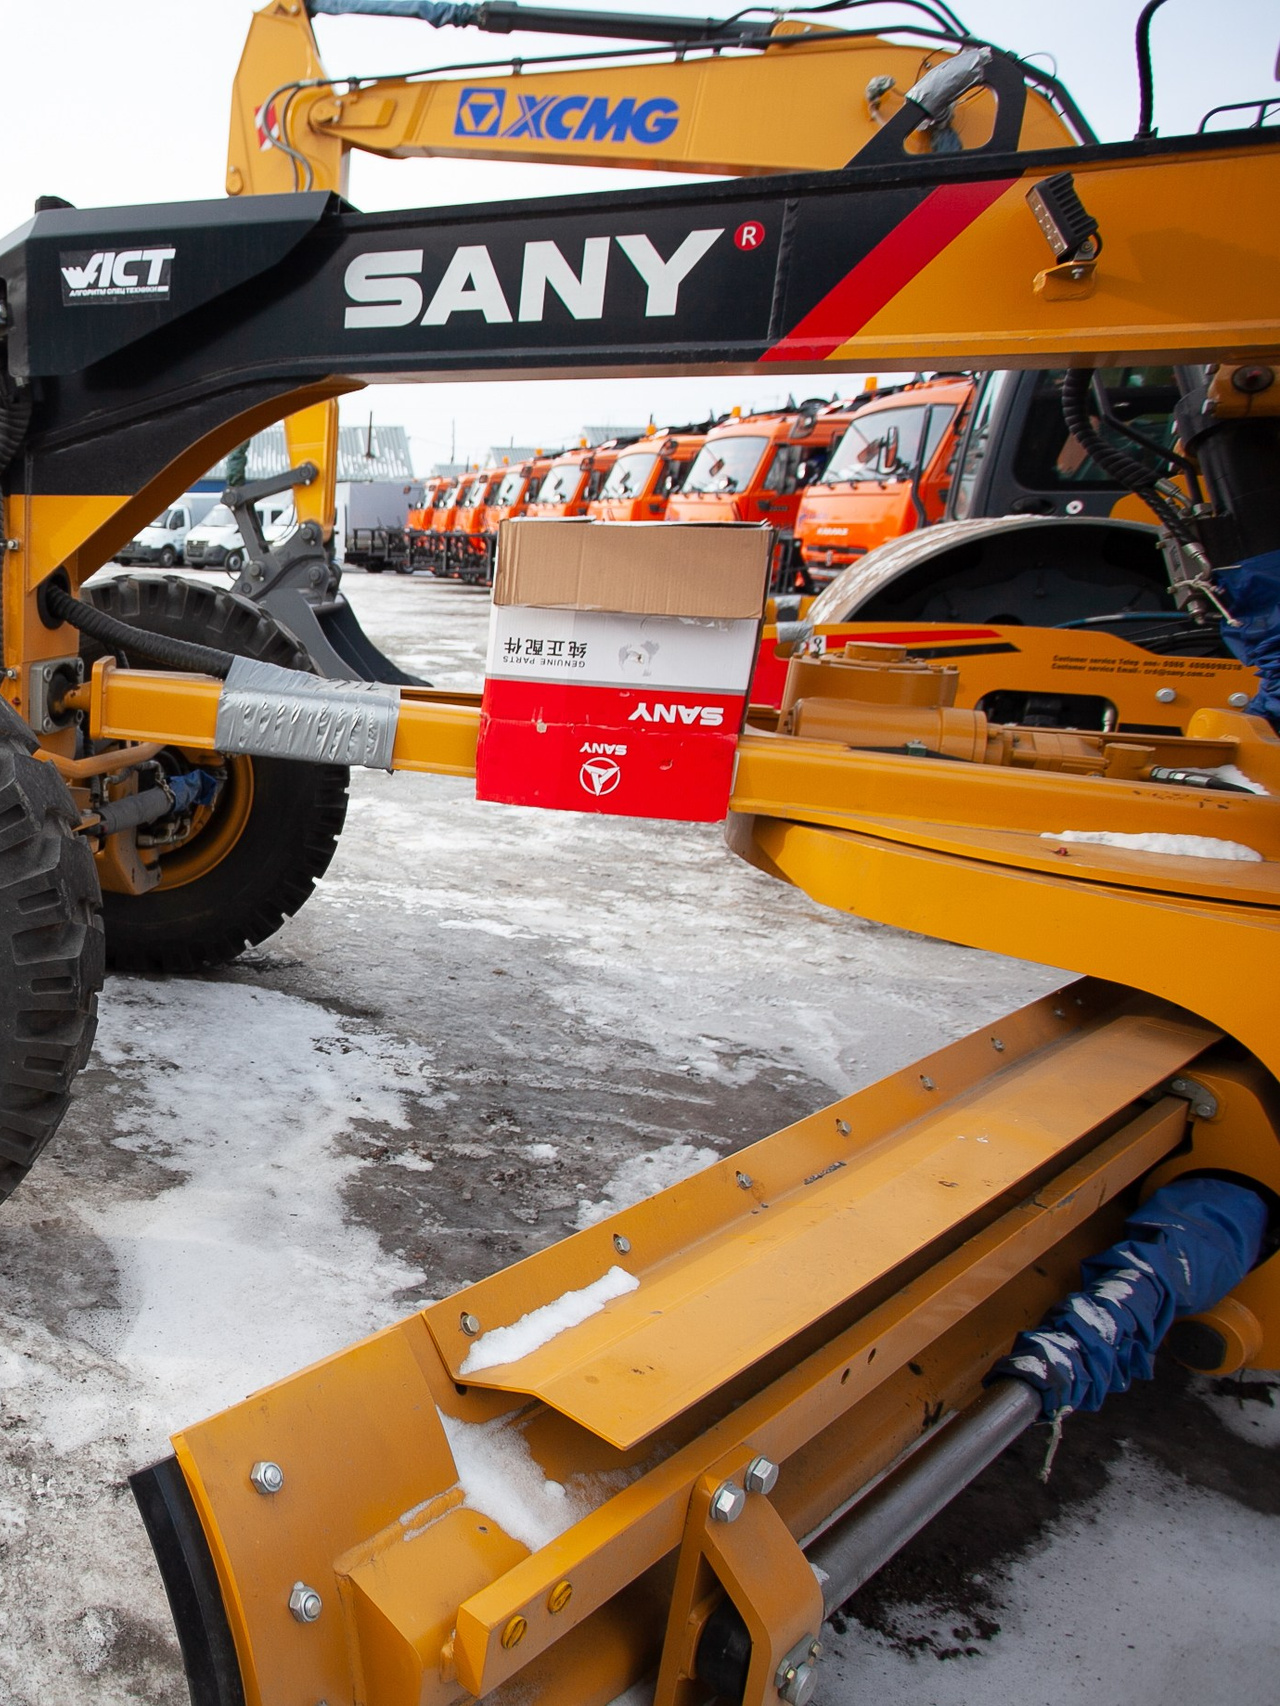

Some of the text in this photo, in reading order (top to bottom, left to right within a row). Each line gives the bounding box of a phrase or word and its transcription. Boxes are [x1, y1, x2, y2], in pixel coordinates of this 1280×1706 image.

[498, 94, 680, 145] XCMG
[344, 228, 725, 329] SANY
[503, 637, 588, 659] 纯正配件
[503, 655, 586, 668] GENUINE PARTS
[628, 702, 724, 727] SANY
[580, 742, 627, 756] SANY
